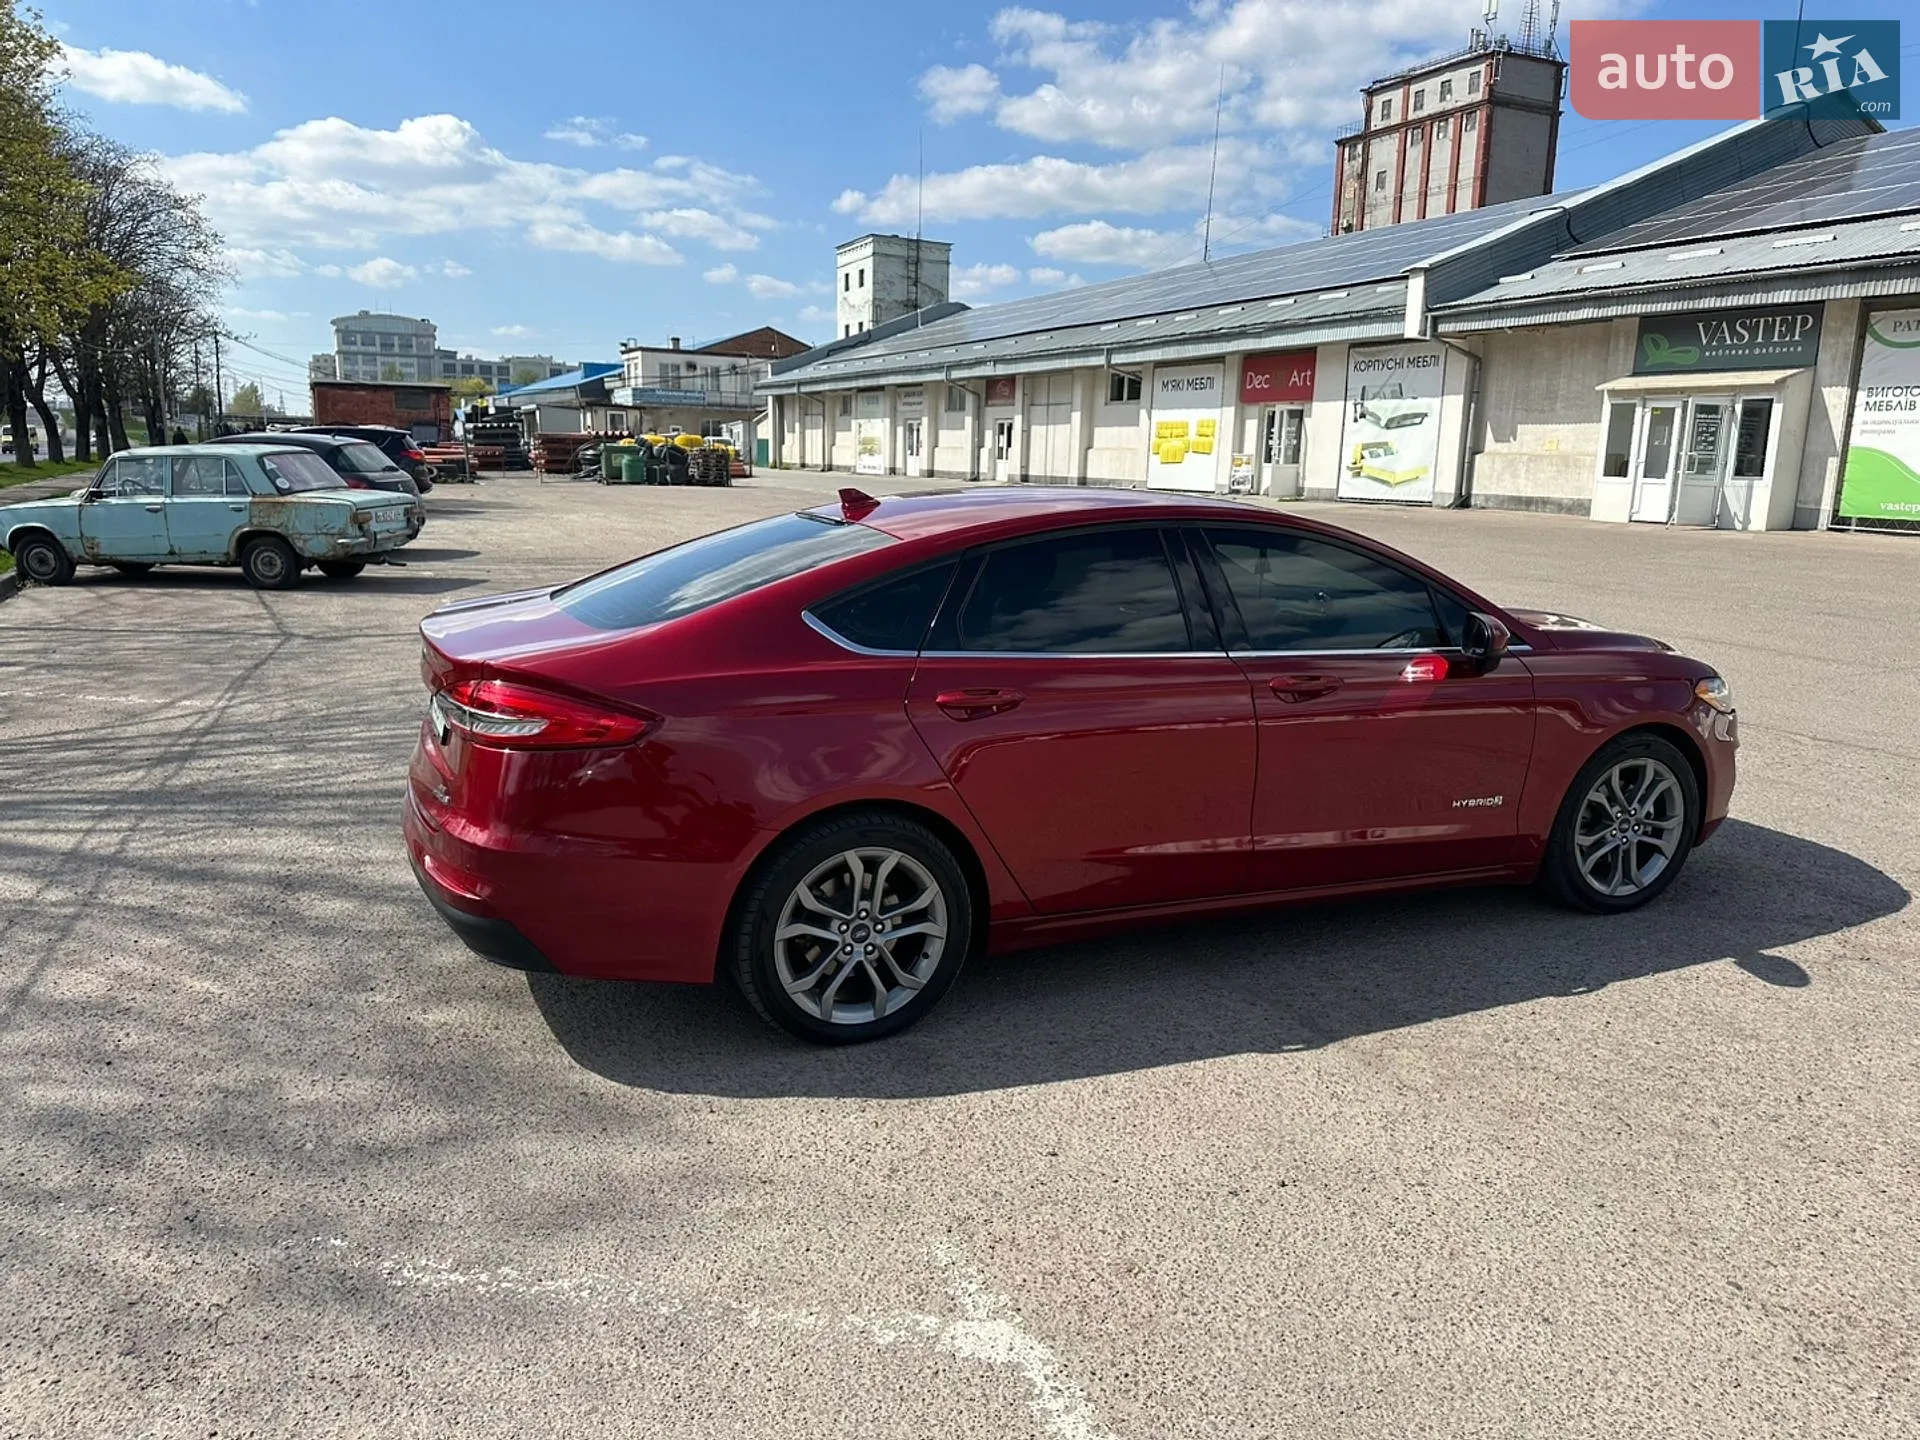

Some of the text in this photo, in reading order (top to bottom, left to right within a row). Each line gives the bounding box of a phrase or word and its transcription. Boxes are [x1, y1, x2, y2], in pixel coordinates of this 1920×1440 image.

[1697, 314, 1813, 345] VASTEP
[1353, 354, 1440, 373] КОРПУСНІ МЕБЛІ
[1161, 376, 1215, 393] М'ЯКІ МЕБЛІ
[1245, 371, 1270, 390] Dec
[1289, 369, 1312, 387] Art
[1452, 798, 1494, 807] HYBRID
